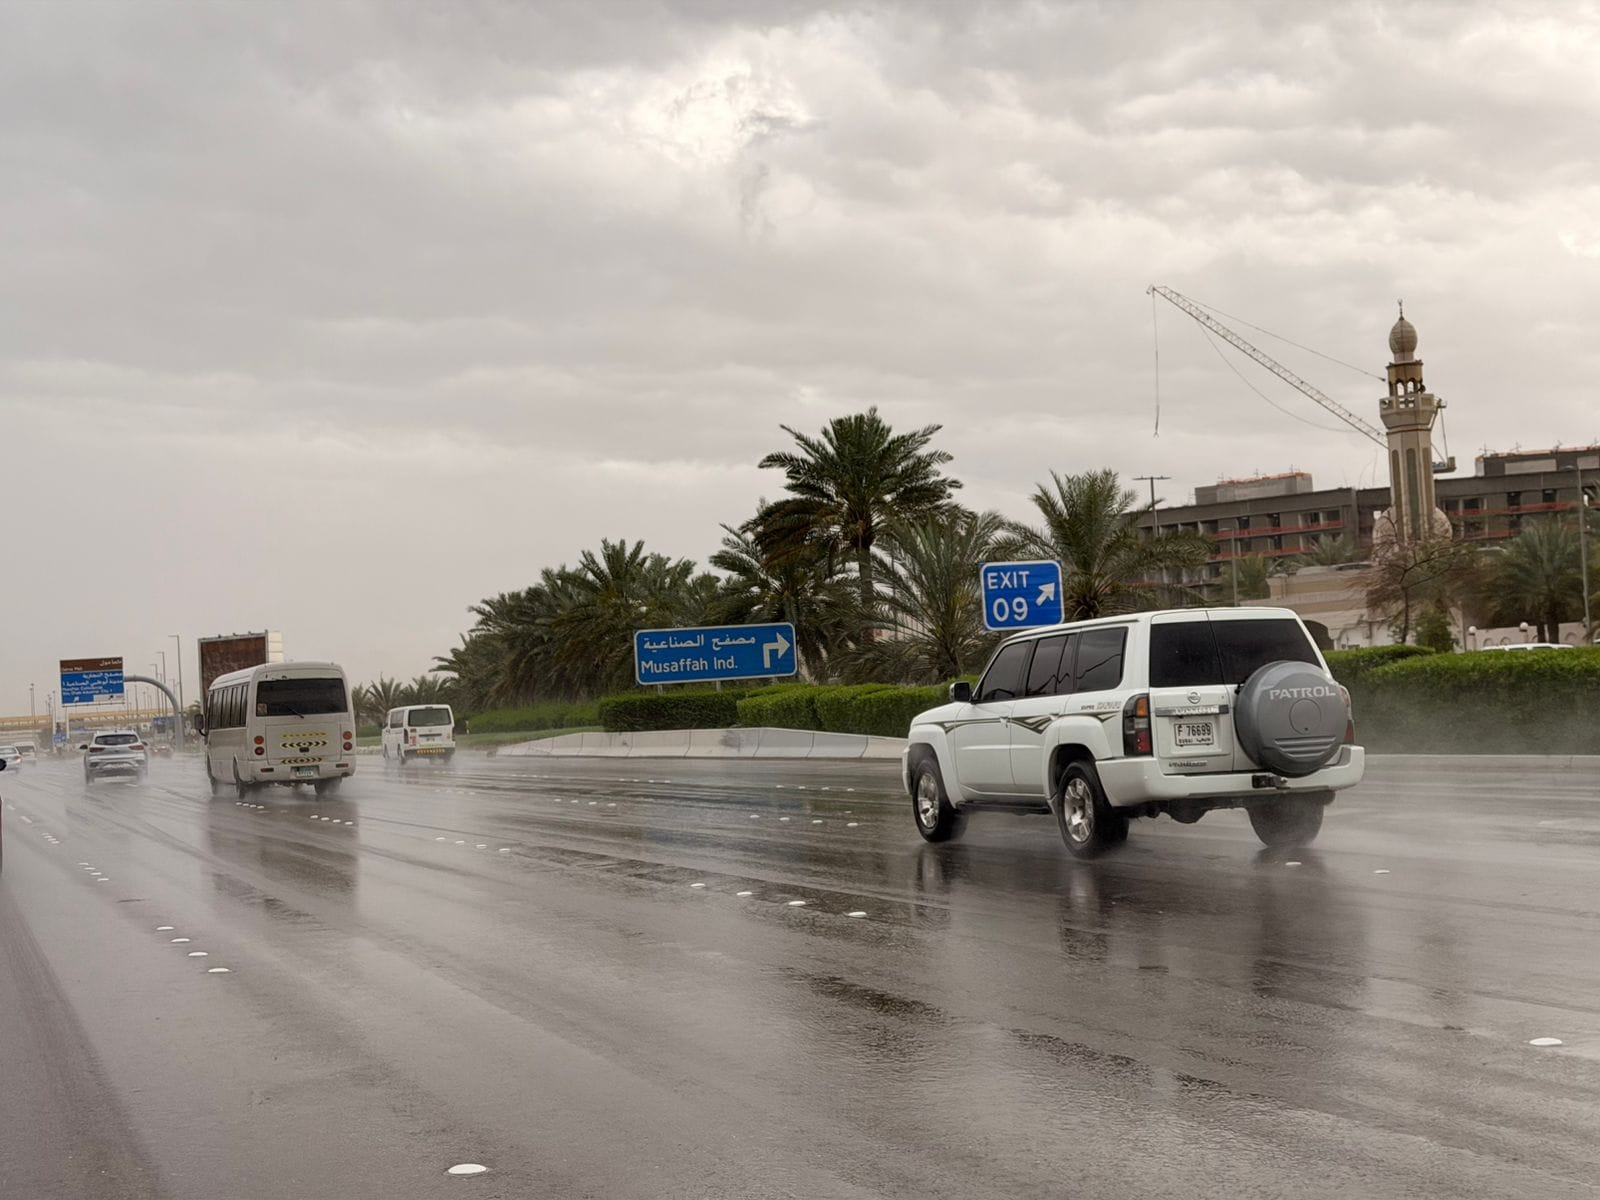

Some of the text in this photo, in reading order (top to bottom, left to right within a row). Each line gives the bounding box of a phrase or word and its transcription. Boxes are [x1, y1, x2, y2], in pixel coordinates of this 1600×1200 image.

[987, 571, 1030, 589] EXIT
[992, 597, 1028, 622] 09
[643, 634, 756, 652] مصفح الصناعية
[641, 655, 738, 674] Musaffah Ind.
[1269, 686, 1336, 700] PATROL
[1186, 724, 1212, 737] 76699
